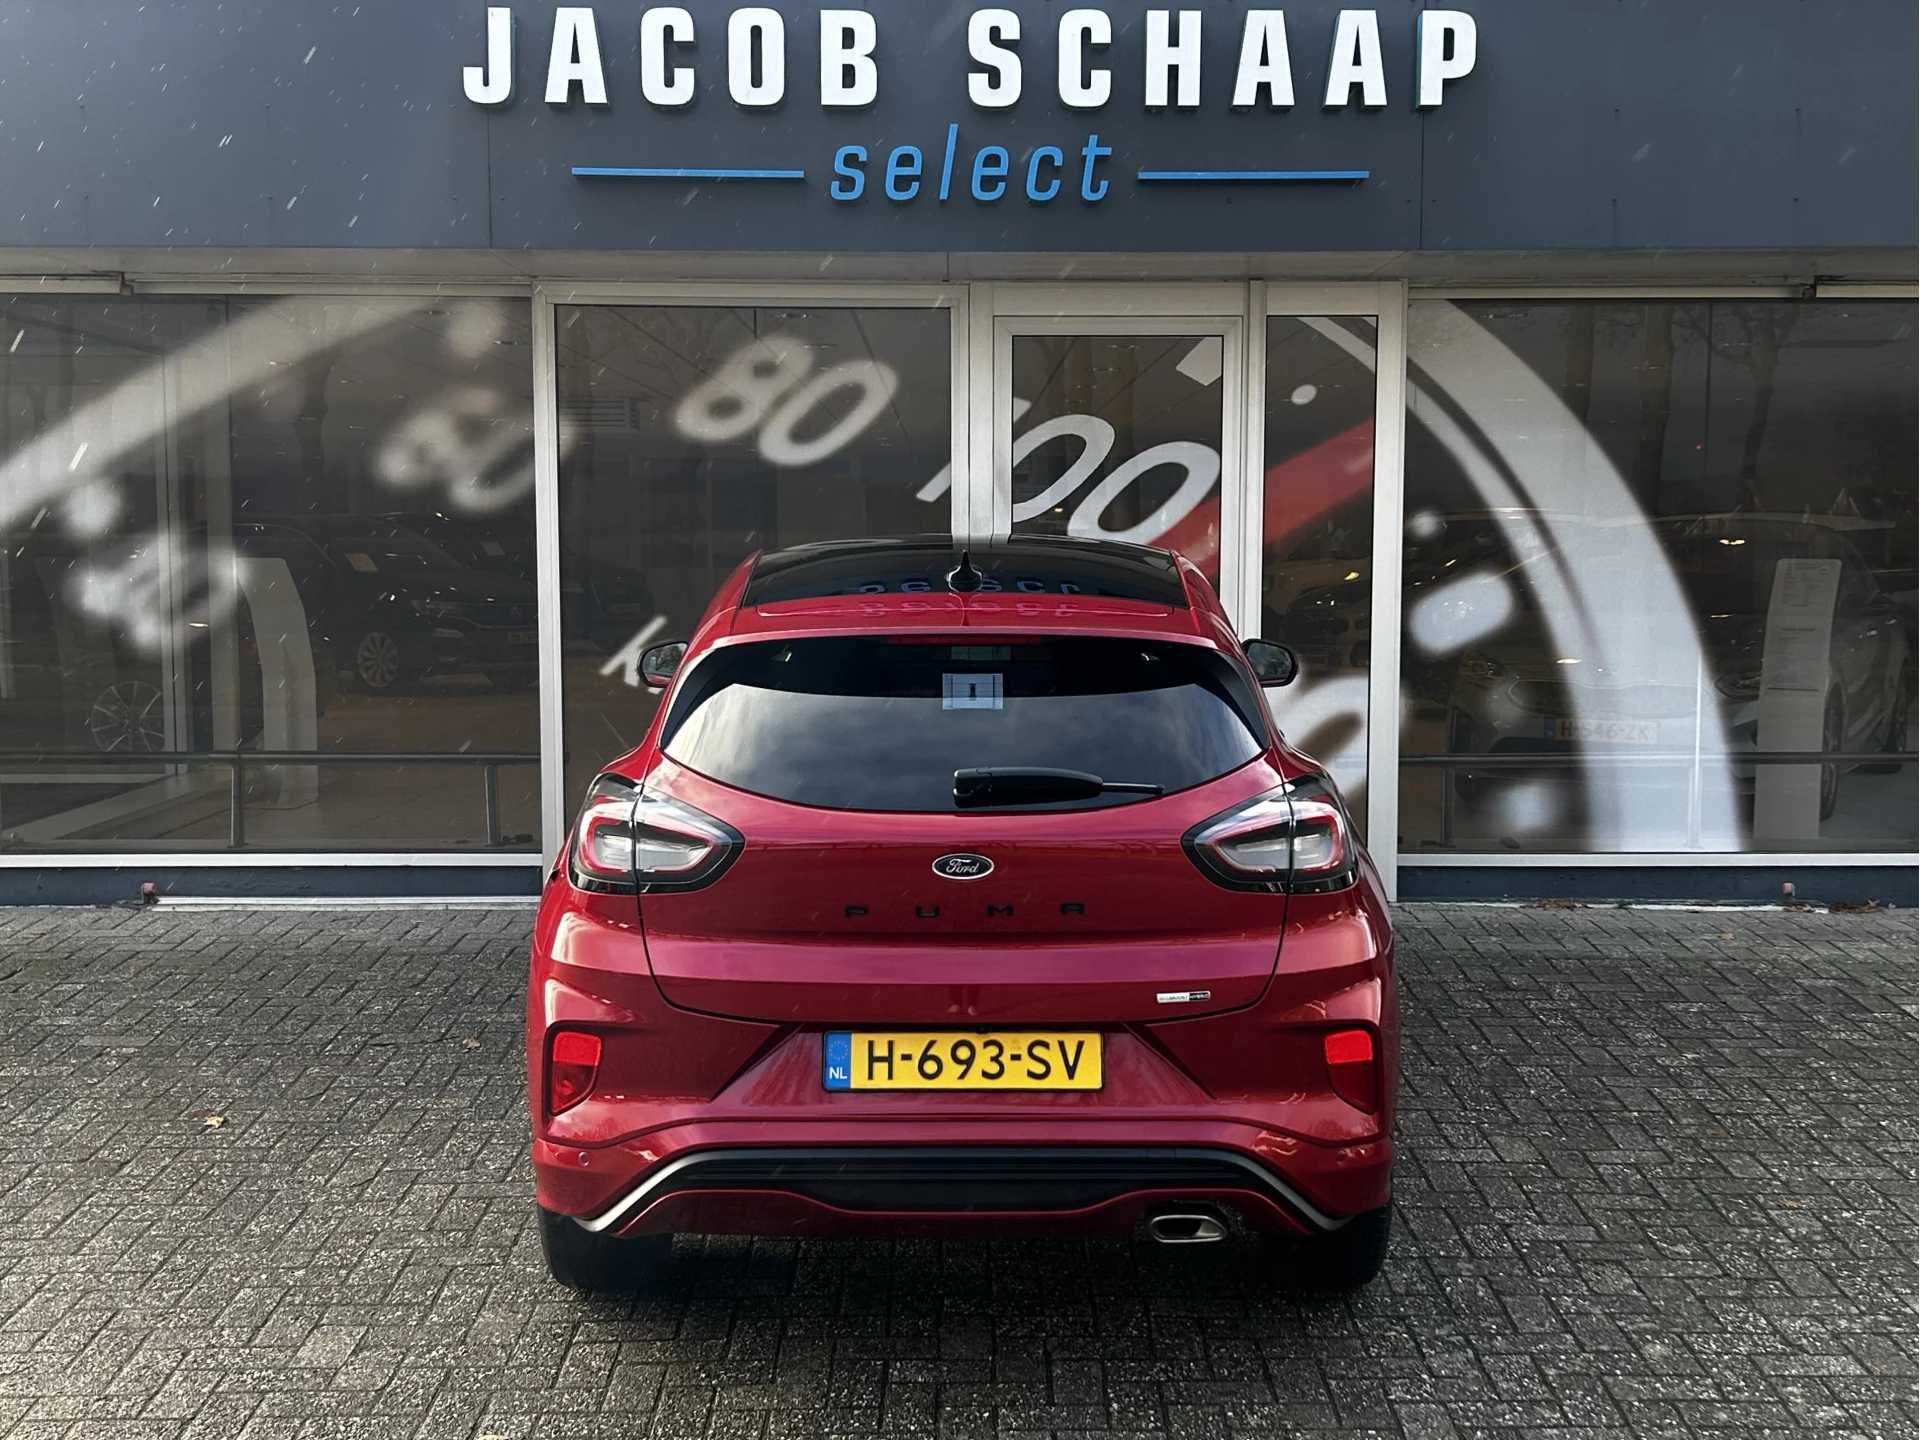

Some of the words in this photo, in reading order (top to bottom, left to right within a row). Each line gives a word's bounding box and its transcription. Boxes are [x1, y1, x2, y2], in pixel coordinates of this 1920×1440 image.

[463, 7, 879, 107] JACOB
[966, 8, 1478, 108] SCHAAP
[829, 123, 1112, 202] select
[674, 334, 898, 466] 80
[945, 857, 980, 874] Ford
[844, 902, 1086, 918] PUMA
[828, 1067, 848, 1080] NL
[867, 1039, 1086, 1081] H-693-SV
